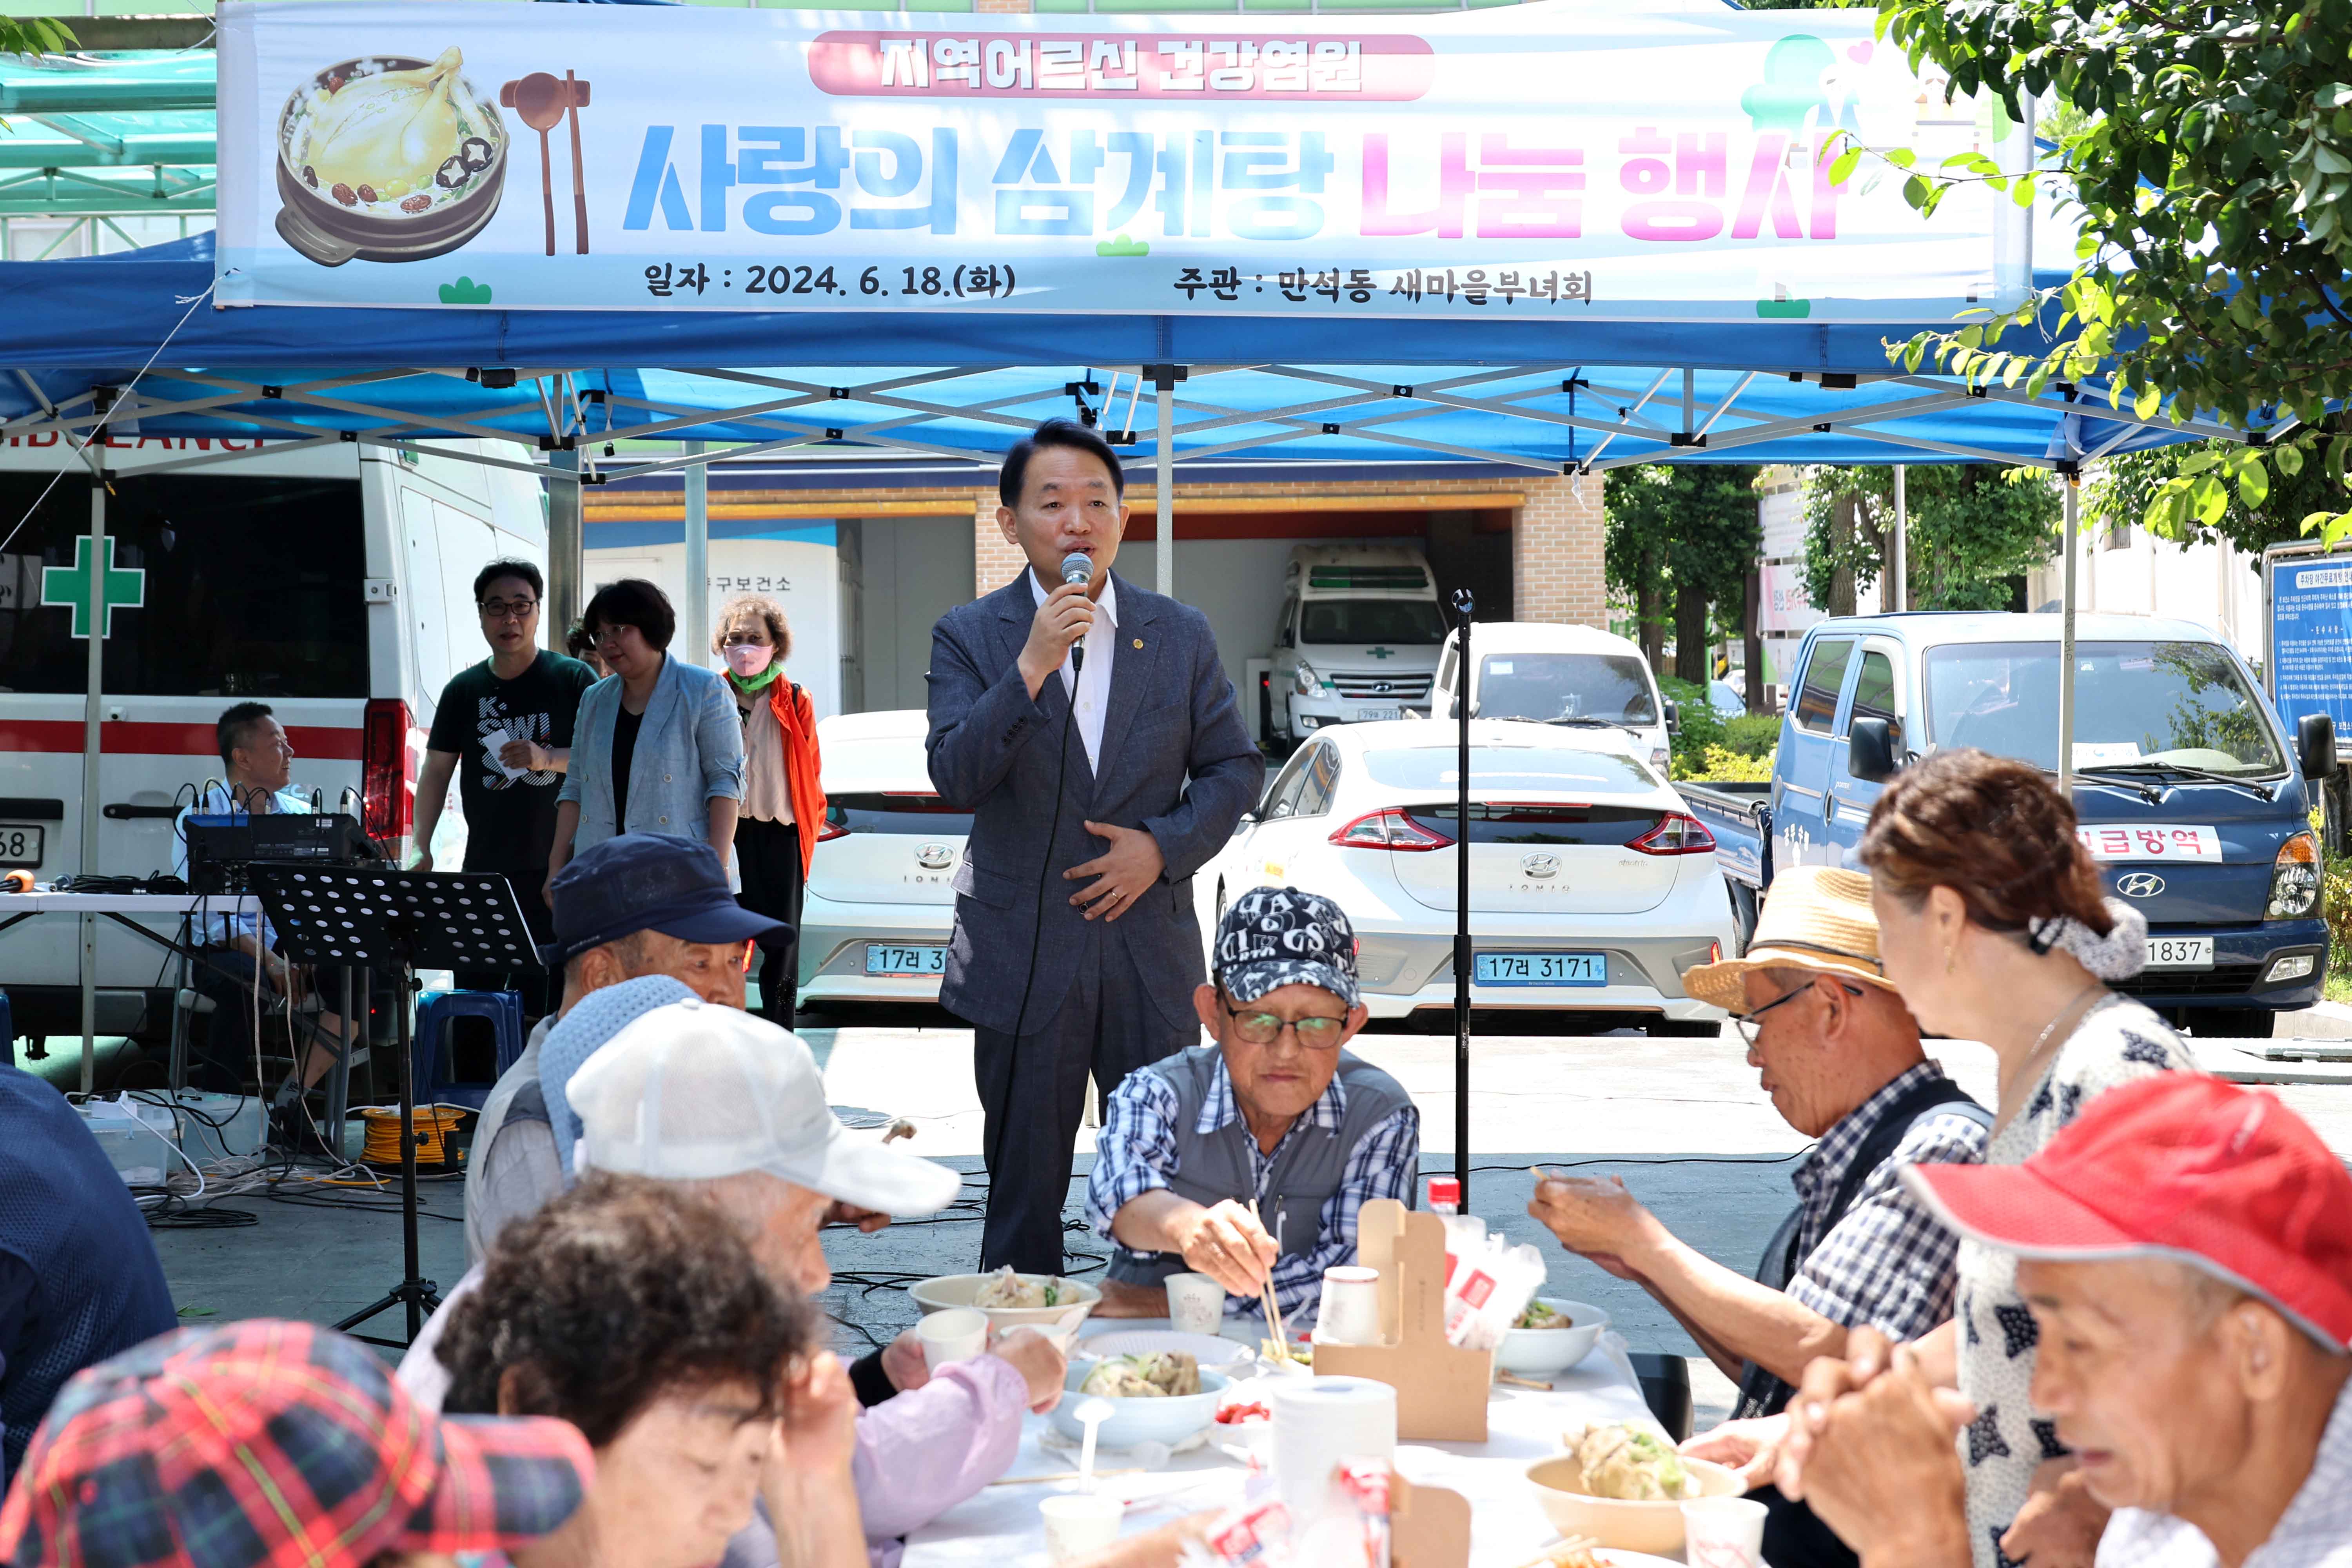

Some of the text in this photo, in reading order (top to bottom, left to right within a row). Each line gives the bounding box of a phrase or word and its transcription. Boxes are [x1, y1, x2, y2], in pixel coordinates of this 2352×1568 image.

[880, 38, 1362, 92] 지역어르신 건강염원
[623, 123, 1848, 241] 사랑의 삼계탕 나눔 행사
[644, 262, 710, 296] 일자
[745, 265, 846, 296] 2024.
[860, 266, 888, 296] 6.
[902, 264, 1015, 298] 18.(화)
[1173, 265, 1242, 301] 주관
[1278, 267, 1377, 304] 만석동
[1388, 269, 1592, 306] 새마을부녀회
[707, 576, 791, 592] 구보건소
[2300, 573, 2314, 585] 주차장
[1509, 884, 1571, 893] IONIQ
[880, 949, 919, 969] 17러
[2148, 942, 2202, 962] 1837
[1490, 958, 1591, 977] 17러 3171
